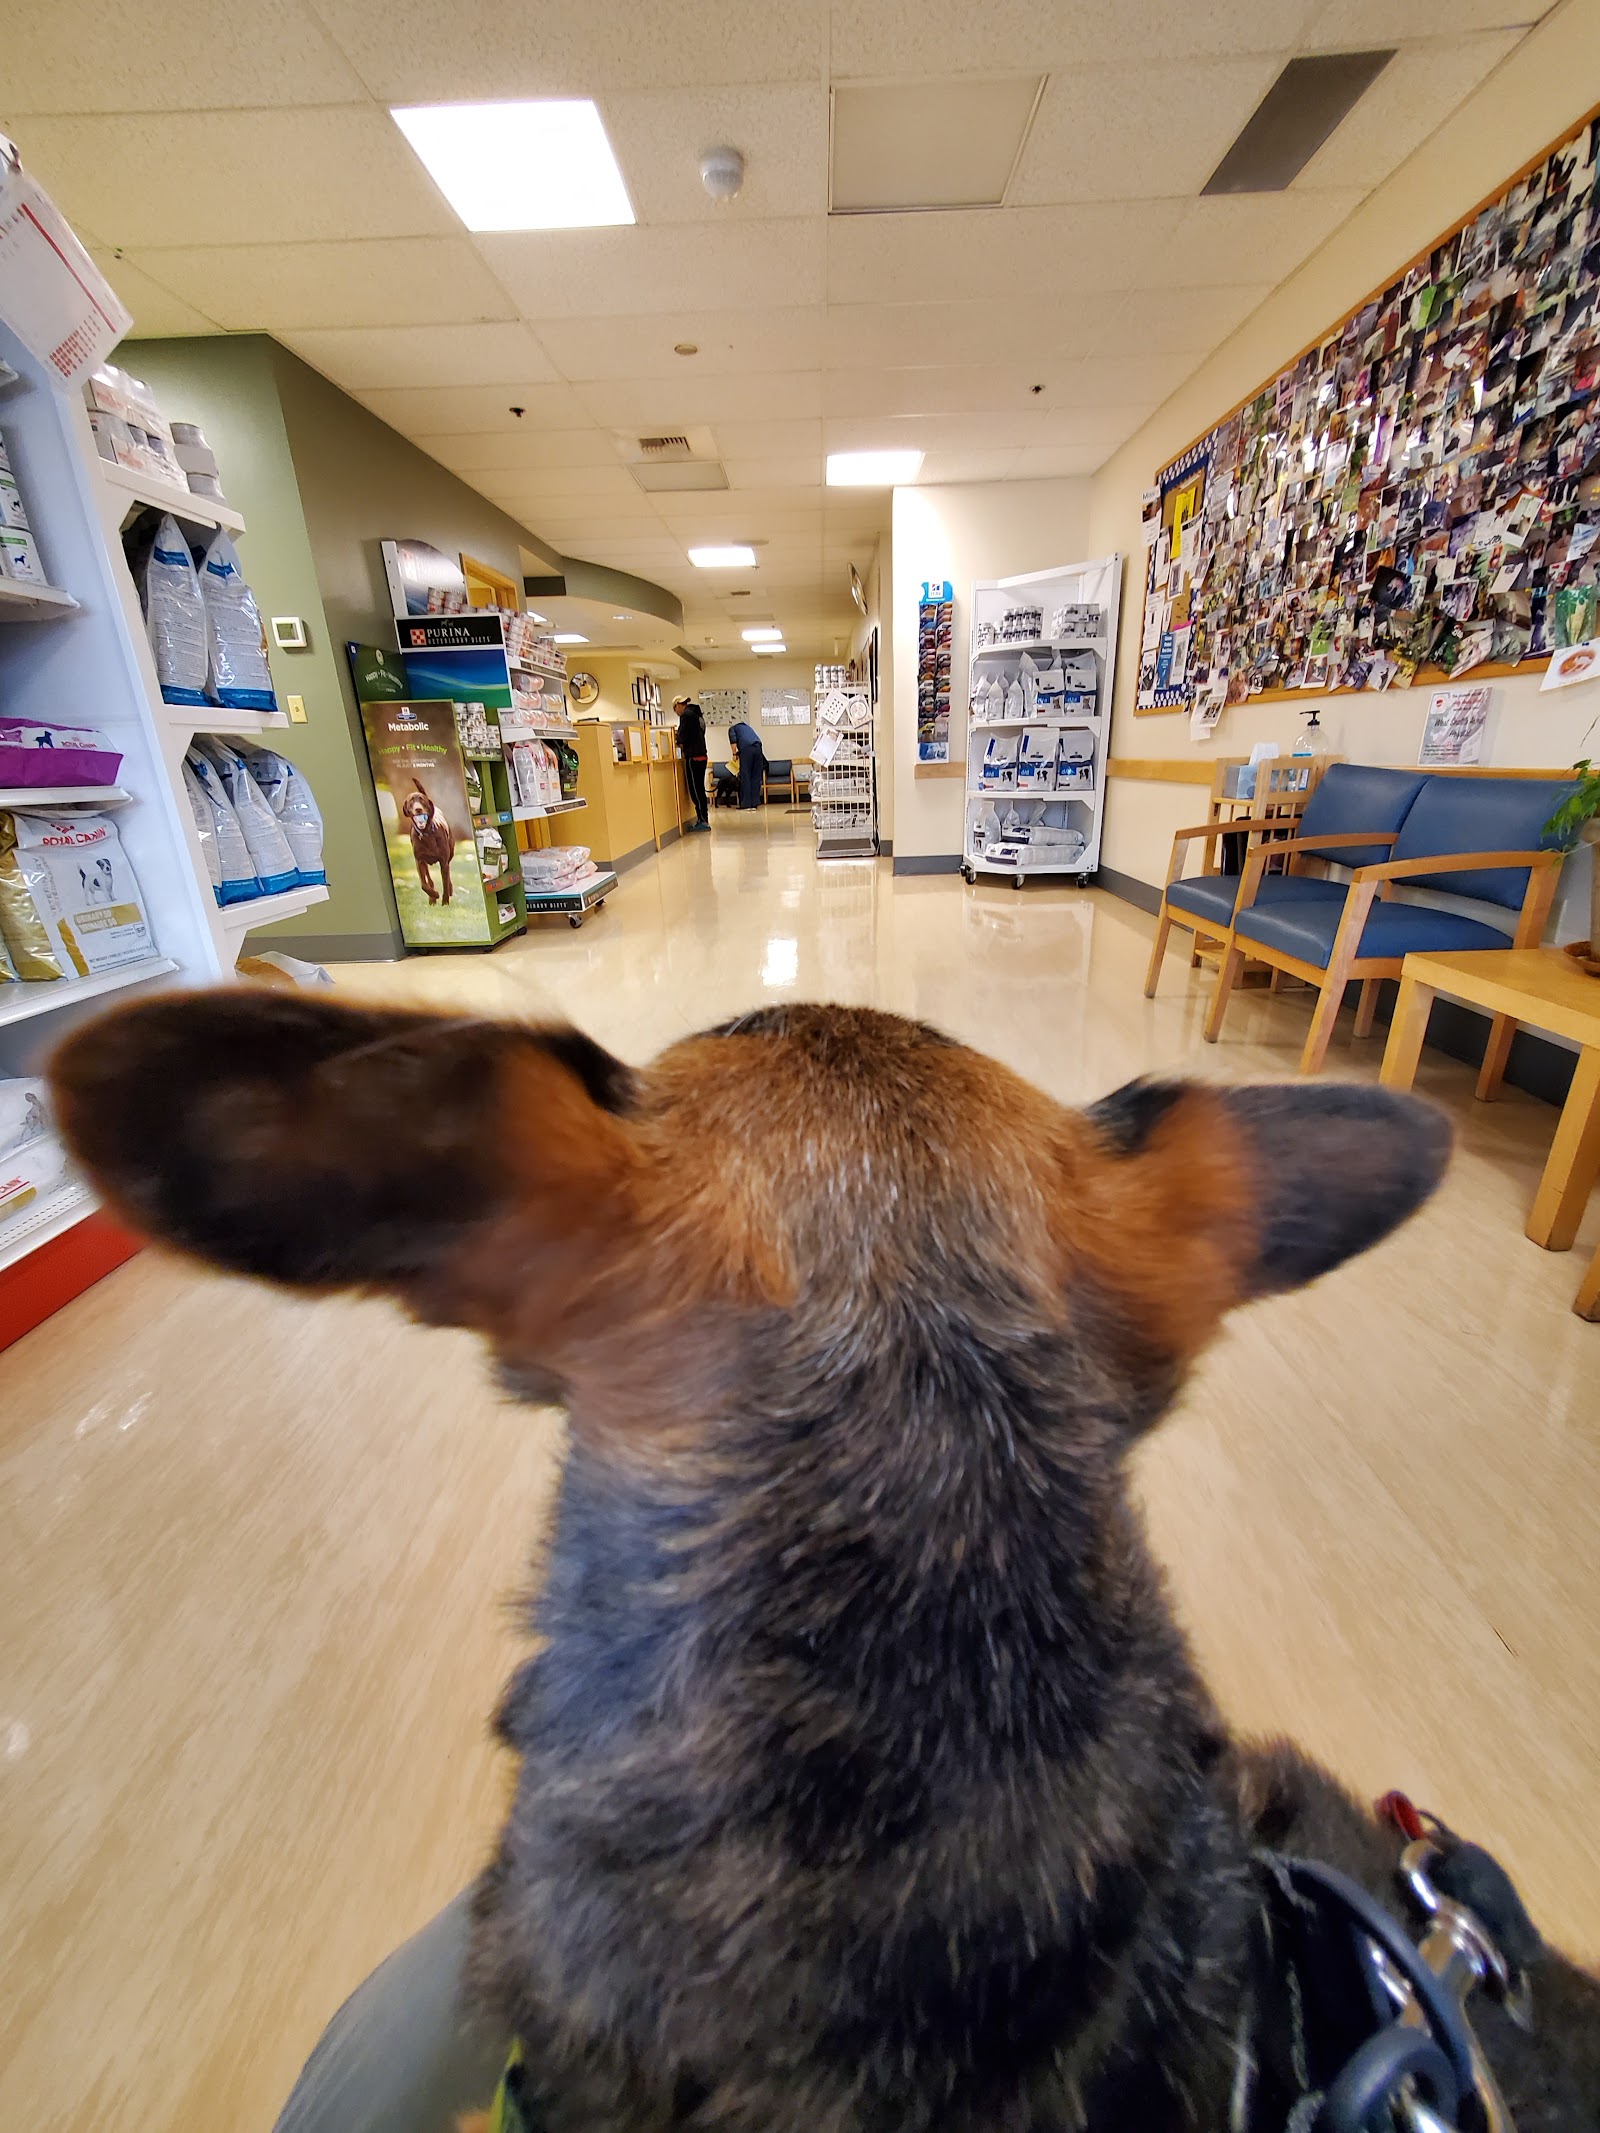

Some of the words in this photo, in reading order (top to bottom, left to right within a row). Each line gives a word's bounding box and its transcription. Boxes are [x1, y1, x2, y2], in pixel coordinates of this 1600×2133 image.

[427, 627, 470, 638] PURINA
[388, 722, 430, 732] Metabolic
[379, 745, 400, 755] Happy
[406, 743, 417, 751] Fit
[421, 744, 448, 755] Healthy
[43, 835, 75, 846] ROYAL
[76, 827, 106, 843] CANIN
[33, 857, 56, 917] VETERINRY
